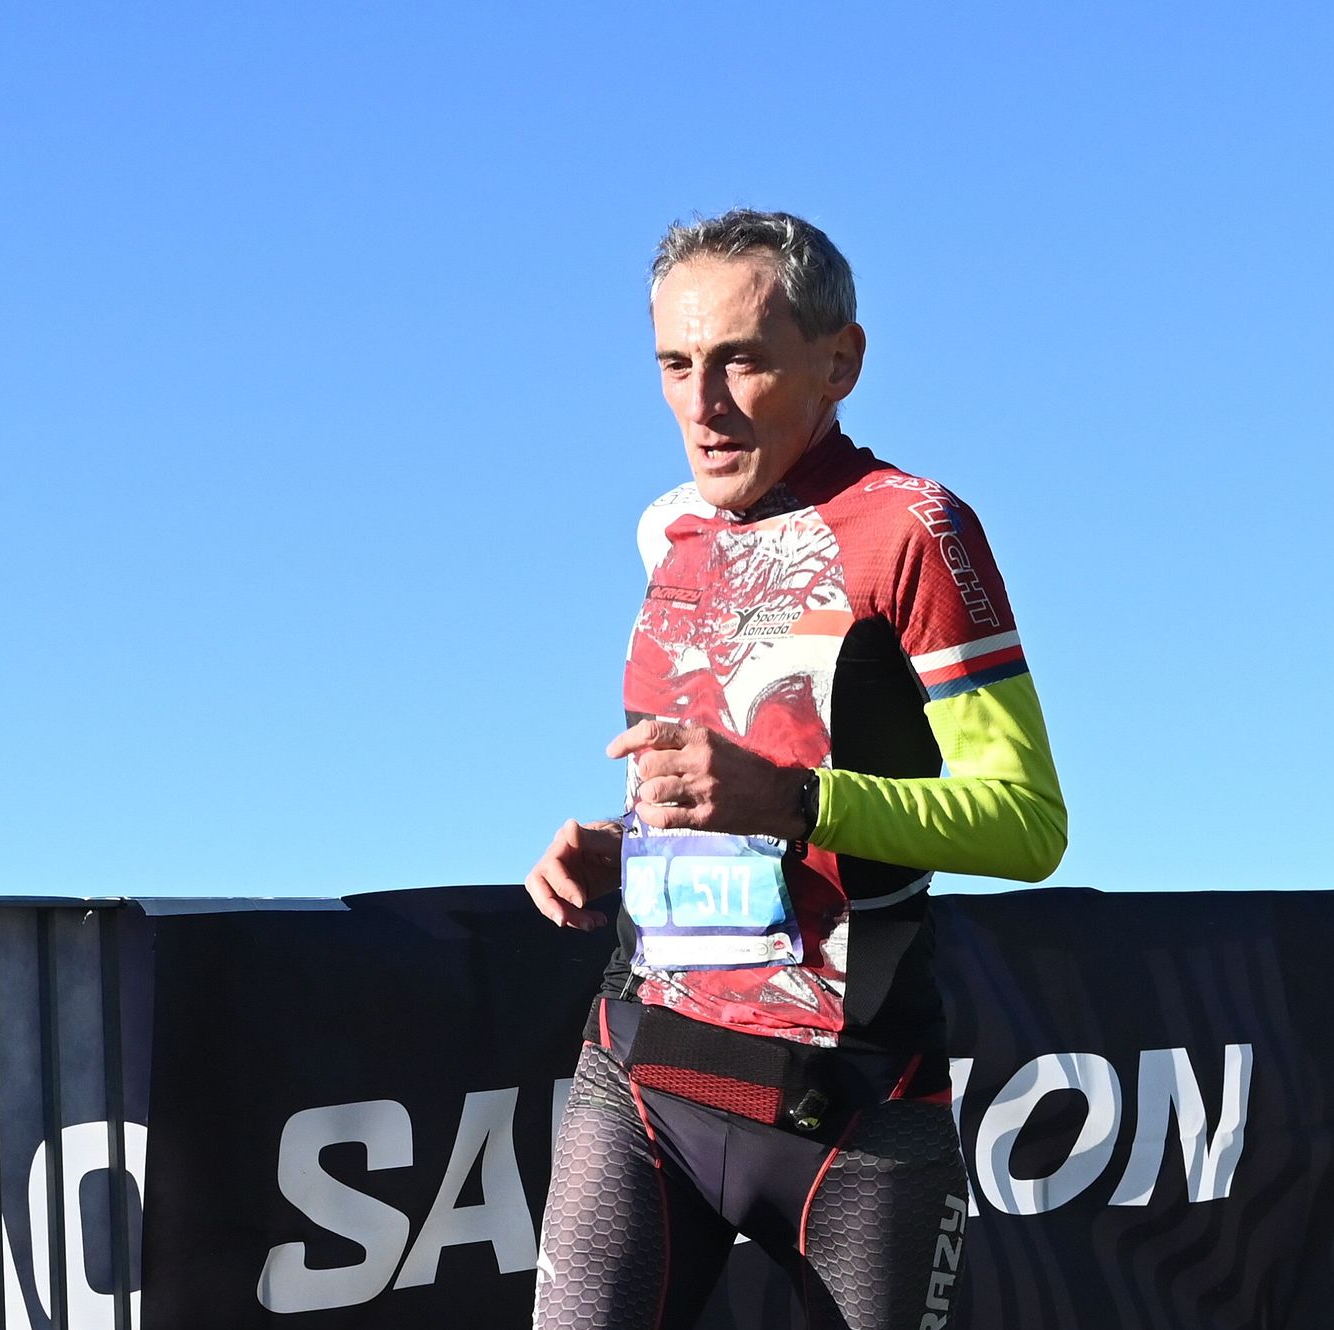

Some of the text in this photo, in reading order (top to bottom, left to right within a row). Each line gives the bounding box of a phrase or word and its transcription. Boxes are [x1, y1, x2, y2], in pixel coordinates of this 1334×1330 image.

[908, 499, 1000, 628] LIGHT
[753, 608, 801, 626] Sportiva
[690, 865, 751, 916] 577
[256, 1043, 1253, 1314] SAON
